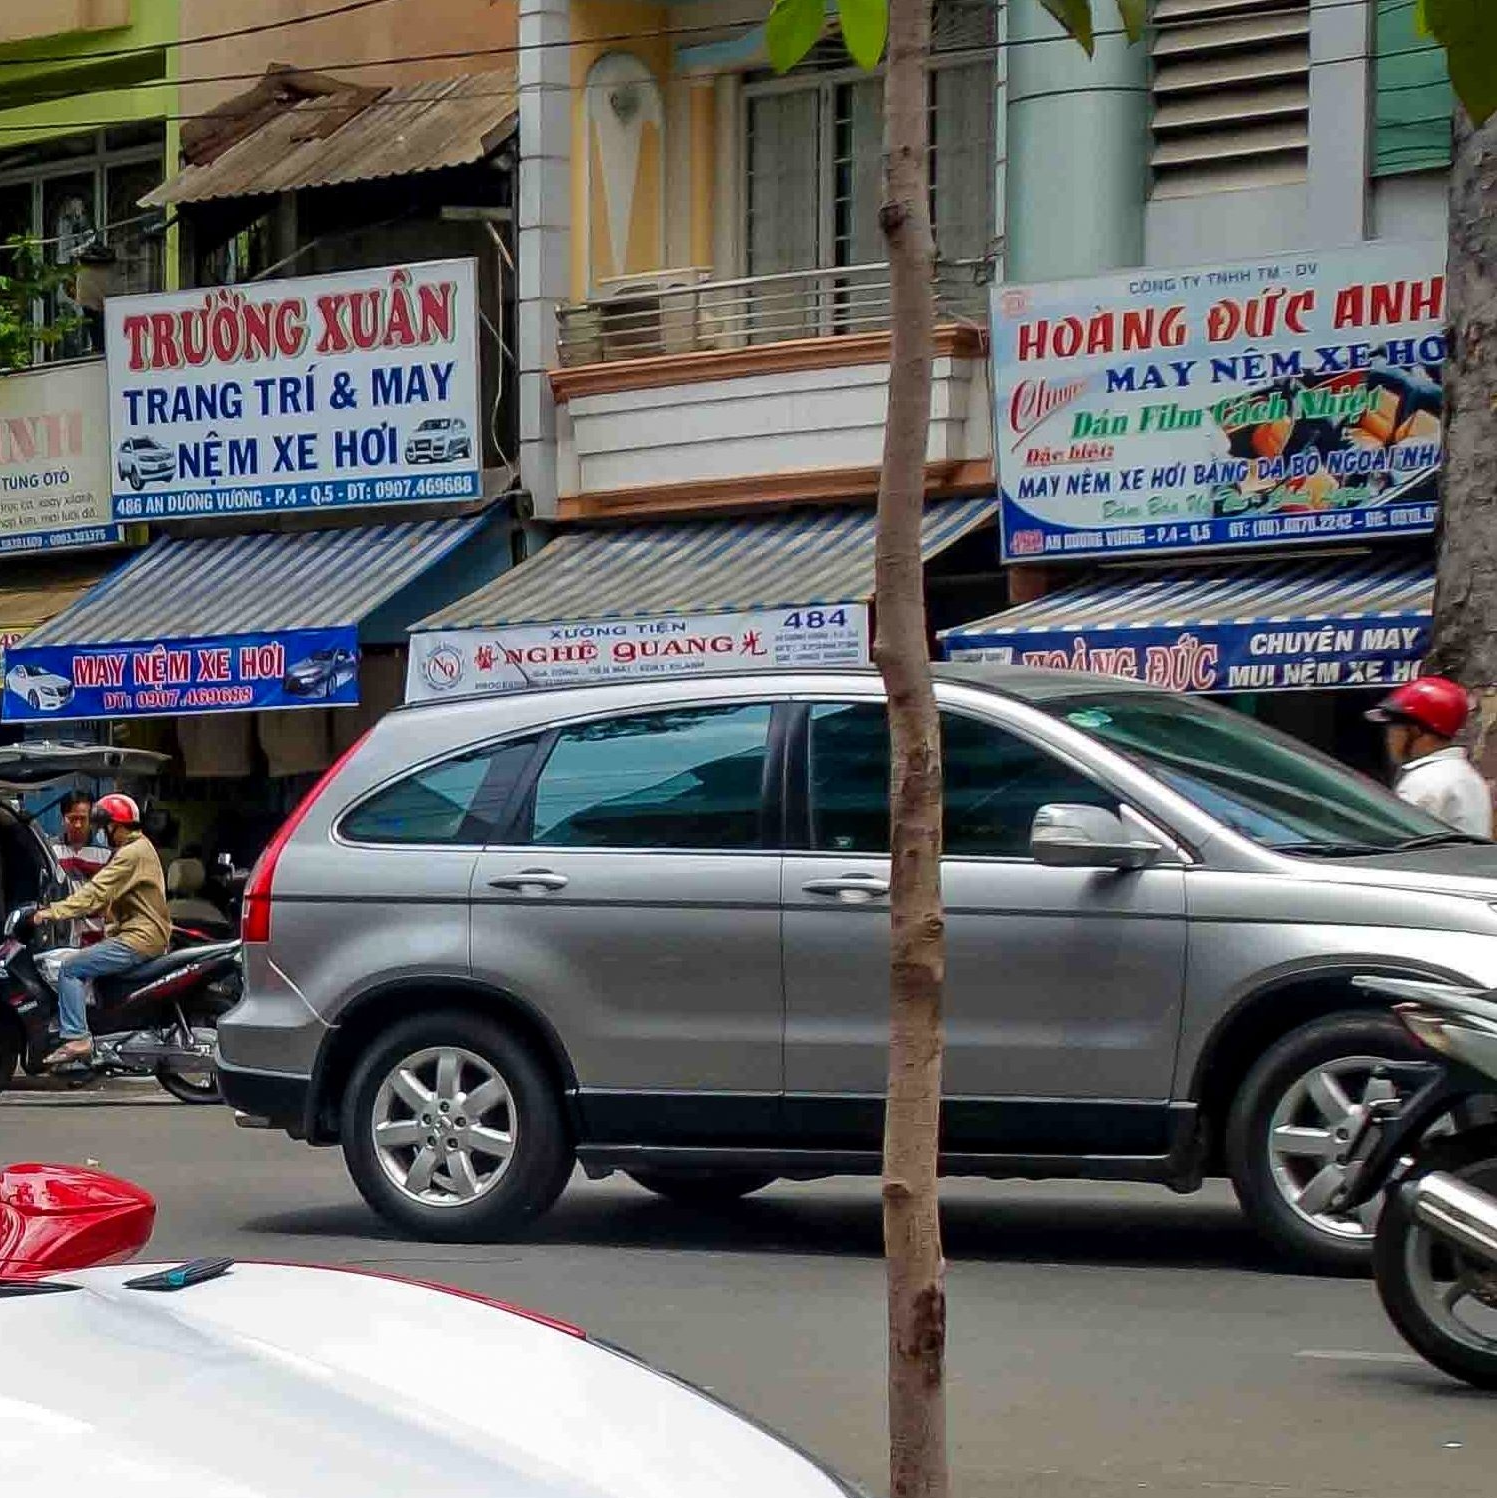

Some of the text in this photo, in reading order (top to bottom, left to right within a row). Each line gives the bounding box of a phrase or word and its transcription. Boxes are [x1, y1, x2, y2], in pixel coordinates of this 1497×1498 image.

[1207, 269, 1251, 286] TNHH
[123, 270, 457, 373] TRƯỜNG XUÂN
[1207, 287, 1316, 343] ĐỨC
[1333, 276, 1444, 330] ANH
[1106, 360, 1198, 393] MAY
[1314, 340, 1372, 373] XE
[123, 360, 455, 426] TRANG TRÍ & MAY
[1137, 403, 1204, 431] Film
[178, 420, 398, 486] NỆM XE HƠI
[1018, 474, 1060, 498] MAY
[1119, 468, 1145, 490] XE
[1150, 461, 1186, 488] HƠI
[1258, 458, 1284, 479] DA
[146, 495, 164, 513] AN
[783, 608, 848, 629] 484
[1361, 627, 1420, 650] MAY
[73, 654, 128, 688] MAY
[197, 647, 232, 682] XE
[240, 640, 285, 680] HƠI
[613, 635, 734, 663] QUANG
[1145, 632, 1218, 692] ĐỨC
[1228, 664, 1276, 688] MUI
[1344, 660, 1384, 683] XE
